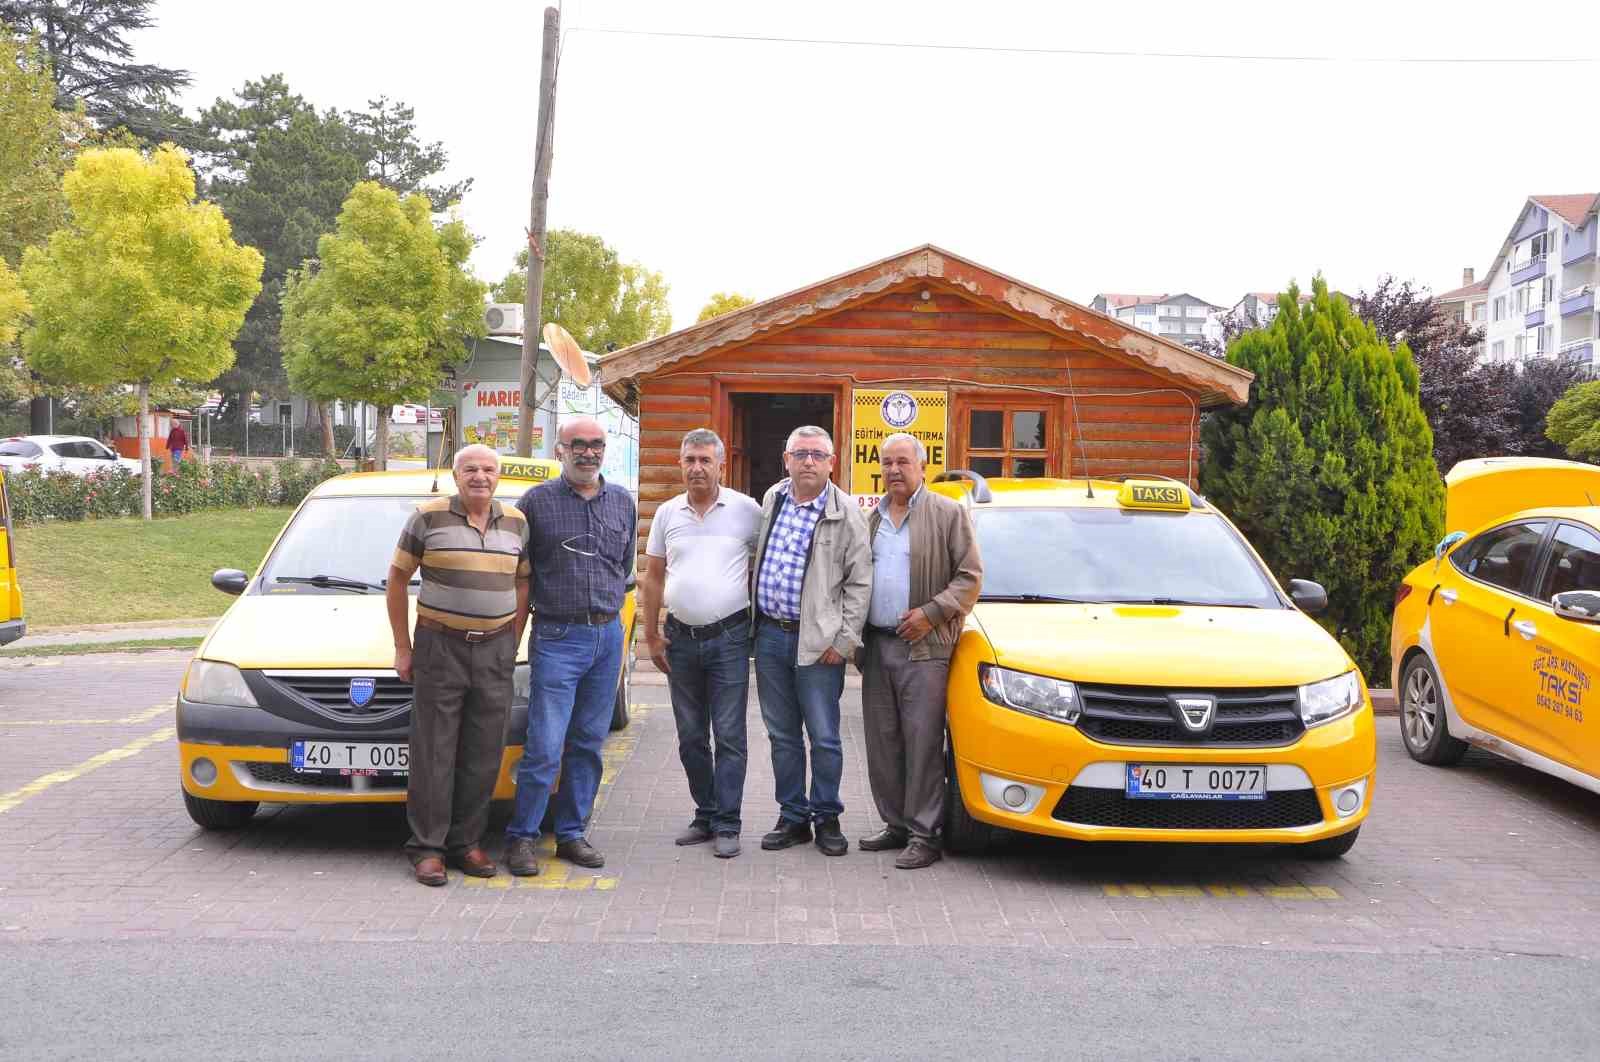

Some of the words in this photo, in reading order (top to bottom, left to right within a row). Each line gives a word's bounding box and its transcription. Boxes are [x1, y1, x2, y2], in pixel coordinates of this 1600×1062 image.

[477, 390, 521, 407] HARIB
[306, 744, 331, 765] 40
[345, 746, 357, 766] T
[370, 746, 409, 767] 005
[1142, 768, 1167, 789] 40
[1182, 769, 1193, 790] T
[1209, 770, 1260, 791] 0077
